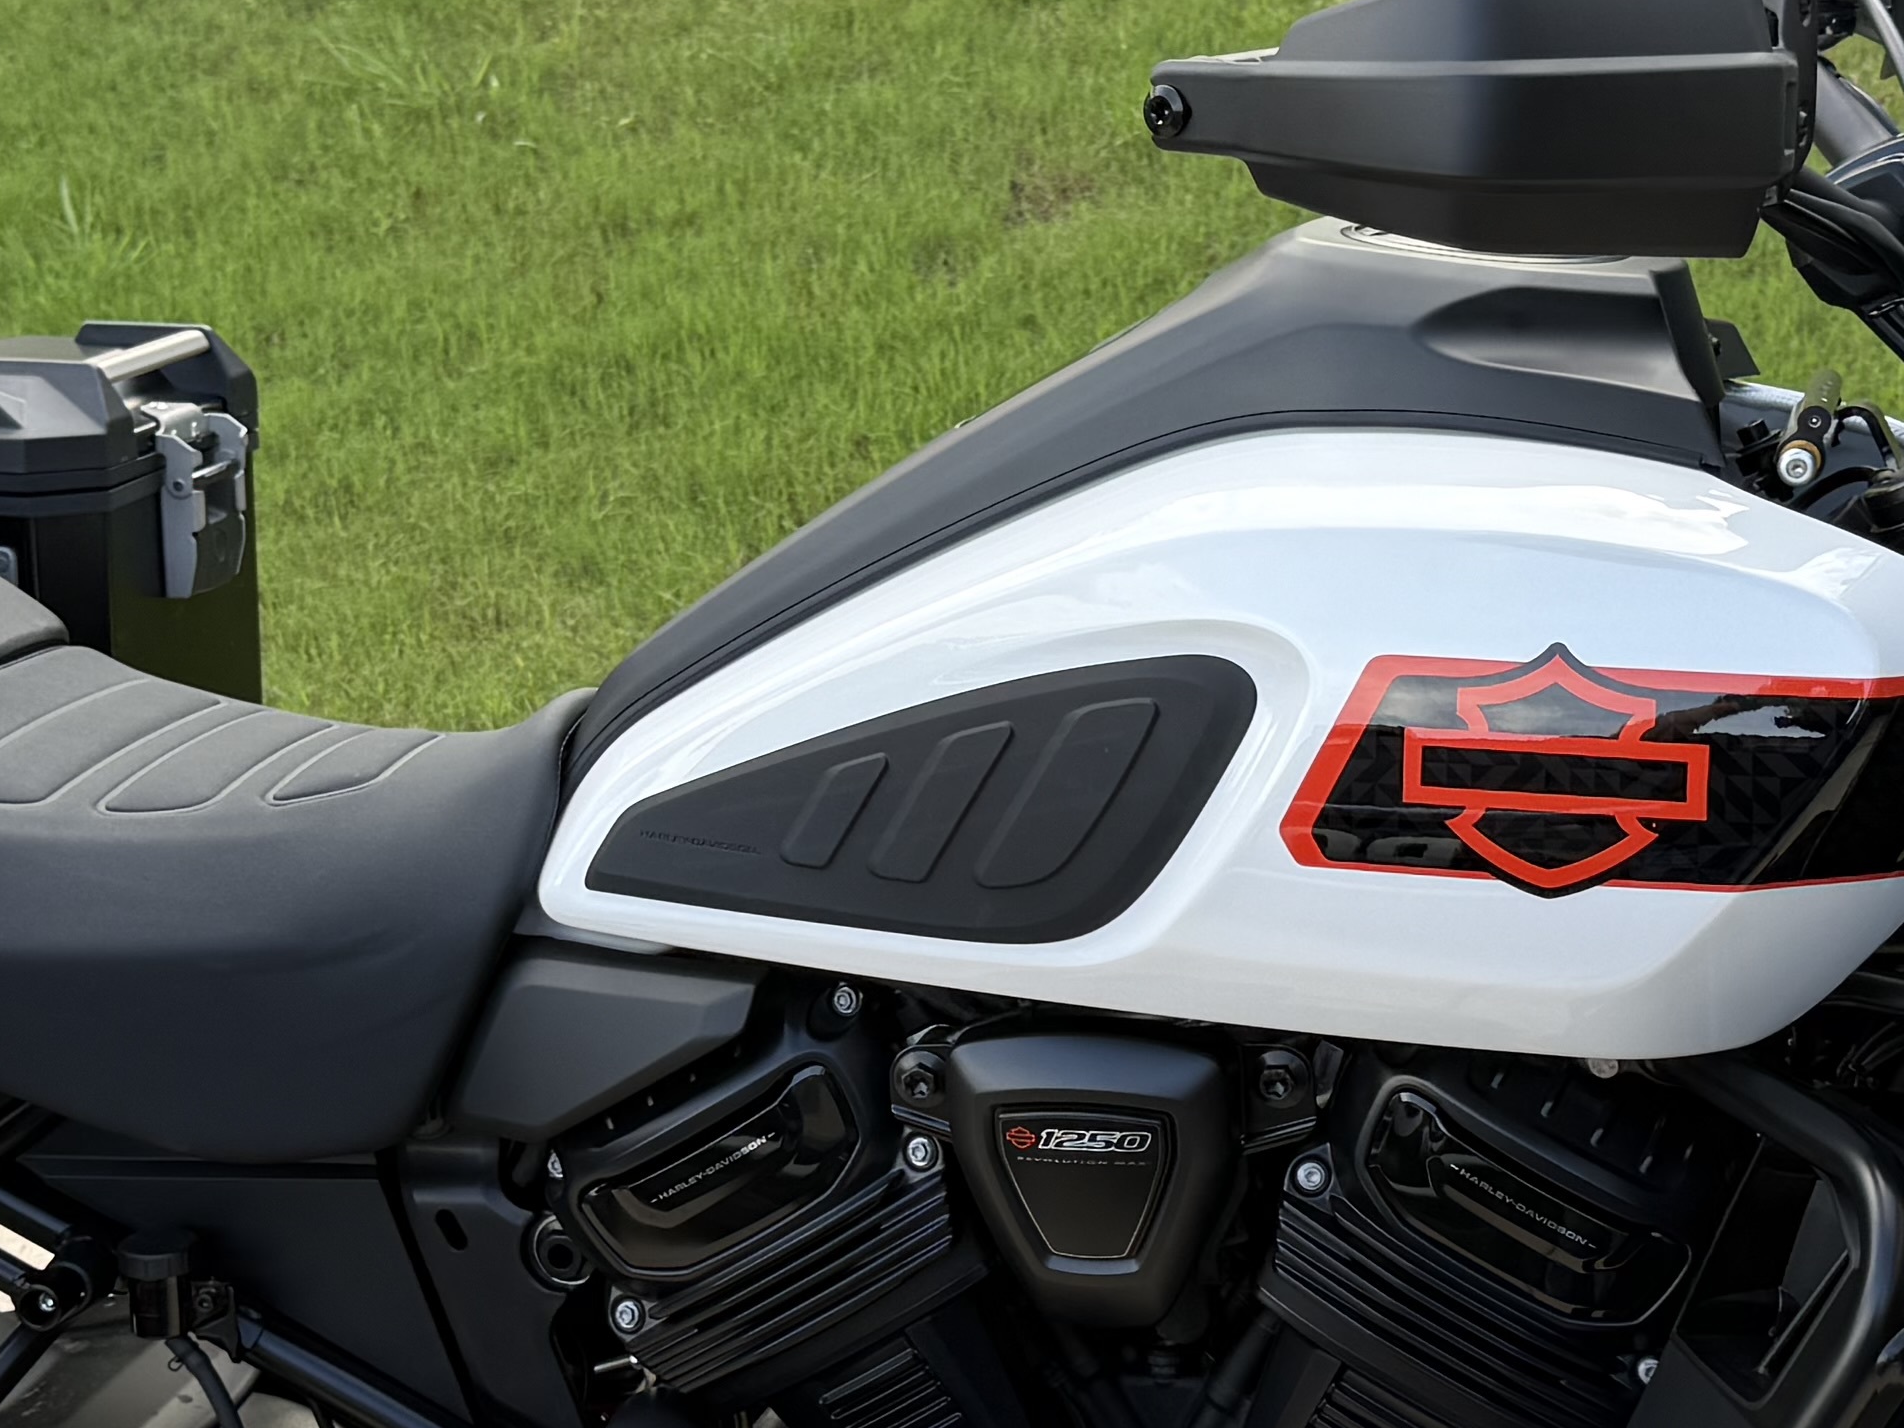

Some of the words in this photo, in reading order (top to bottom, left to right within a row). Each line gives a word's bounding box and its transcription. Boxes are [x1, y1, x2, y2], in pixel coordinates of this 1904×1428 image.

[658, 1135, 767, 1200] HARLEY-DAVIDSON
[1038, 1128, 1153, 1153] 1250
[1459, 1168, 1588, 1246] HARLEY-DAVIDSON
